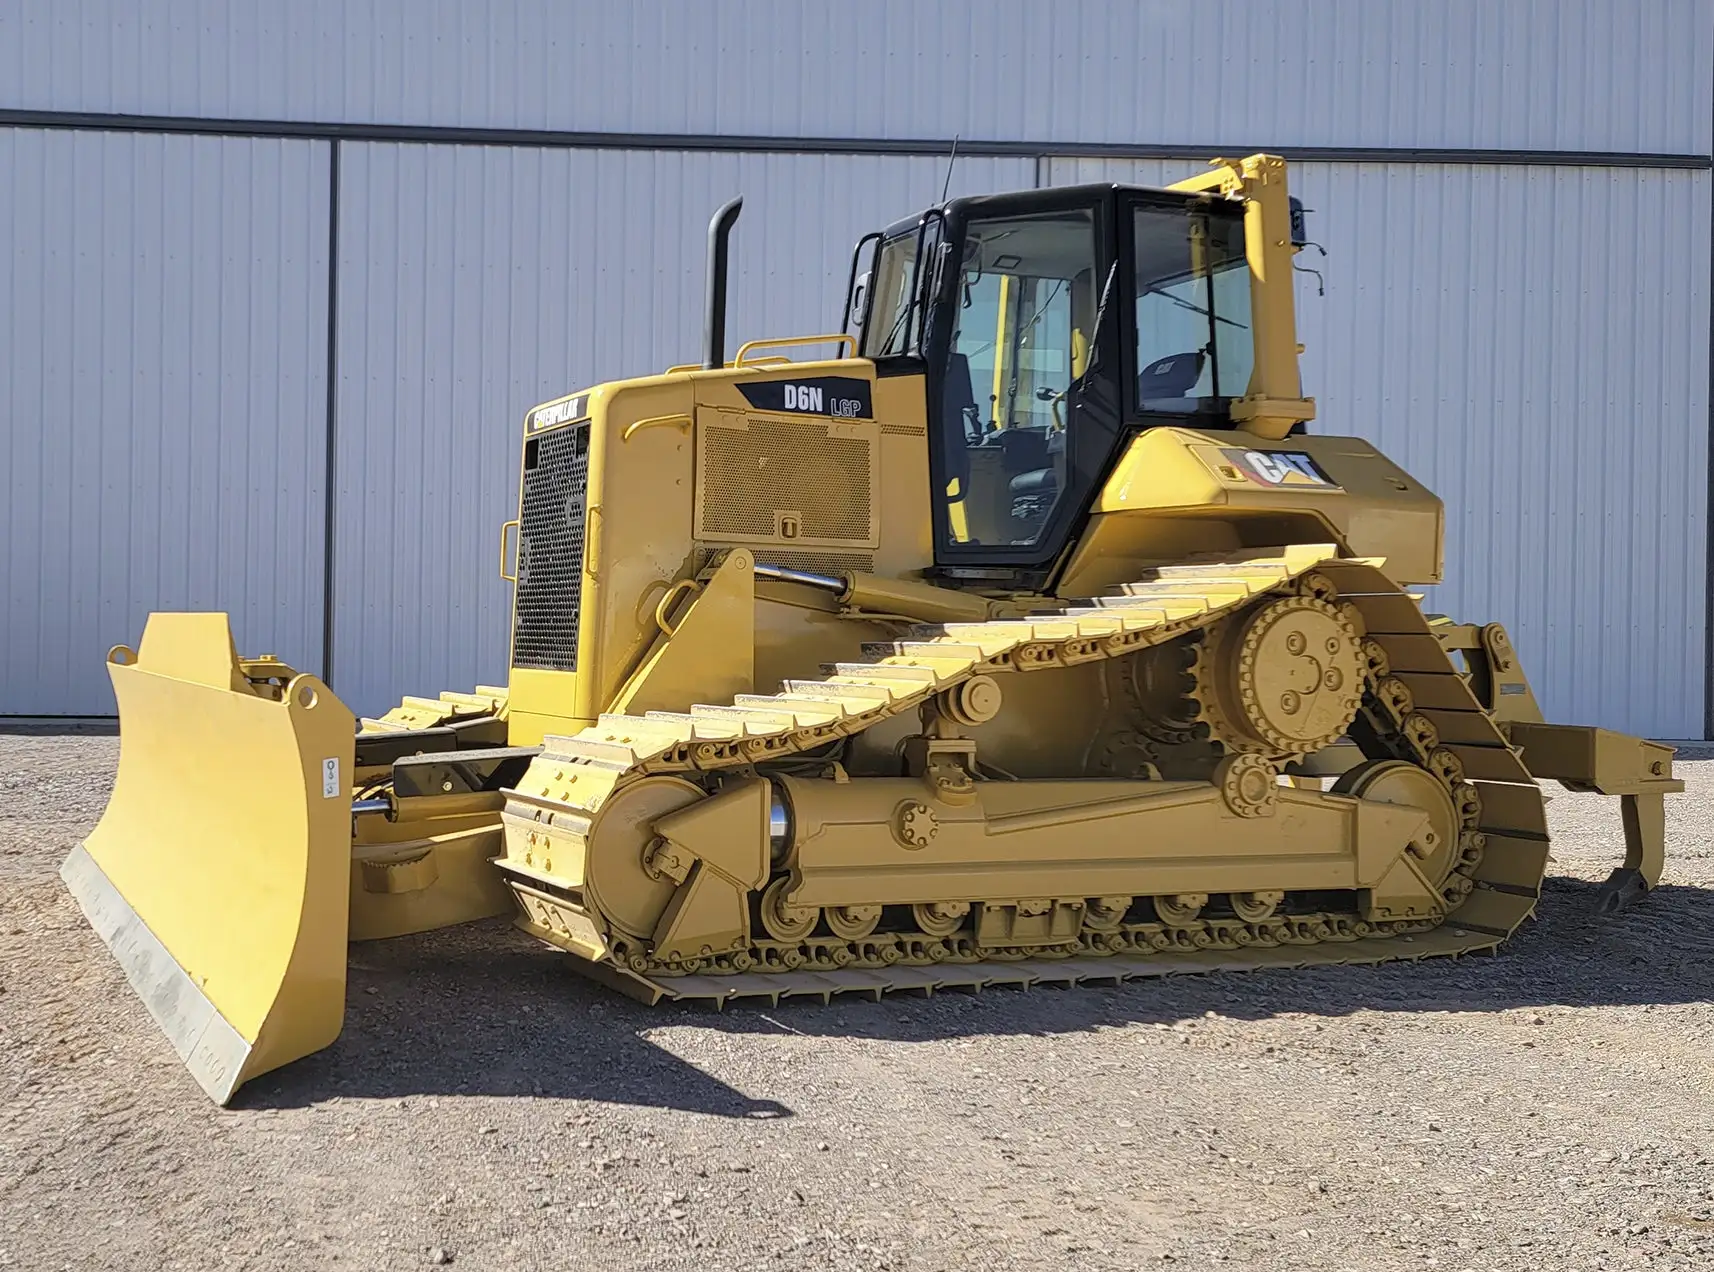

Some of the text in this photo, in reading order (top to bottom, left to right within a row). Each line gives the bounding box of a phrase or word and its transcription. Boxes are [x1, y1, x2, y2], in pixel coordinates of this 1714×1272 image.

[534, 399, 578, 429] CATERPILLAR
[784, 384, 862, 417] D6N LGP
[1244, 451, 1326, 485] CAT
